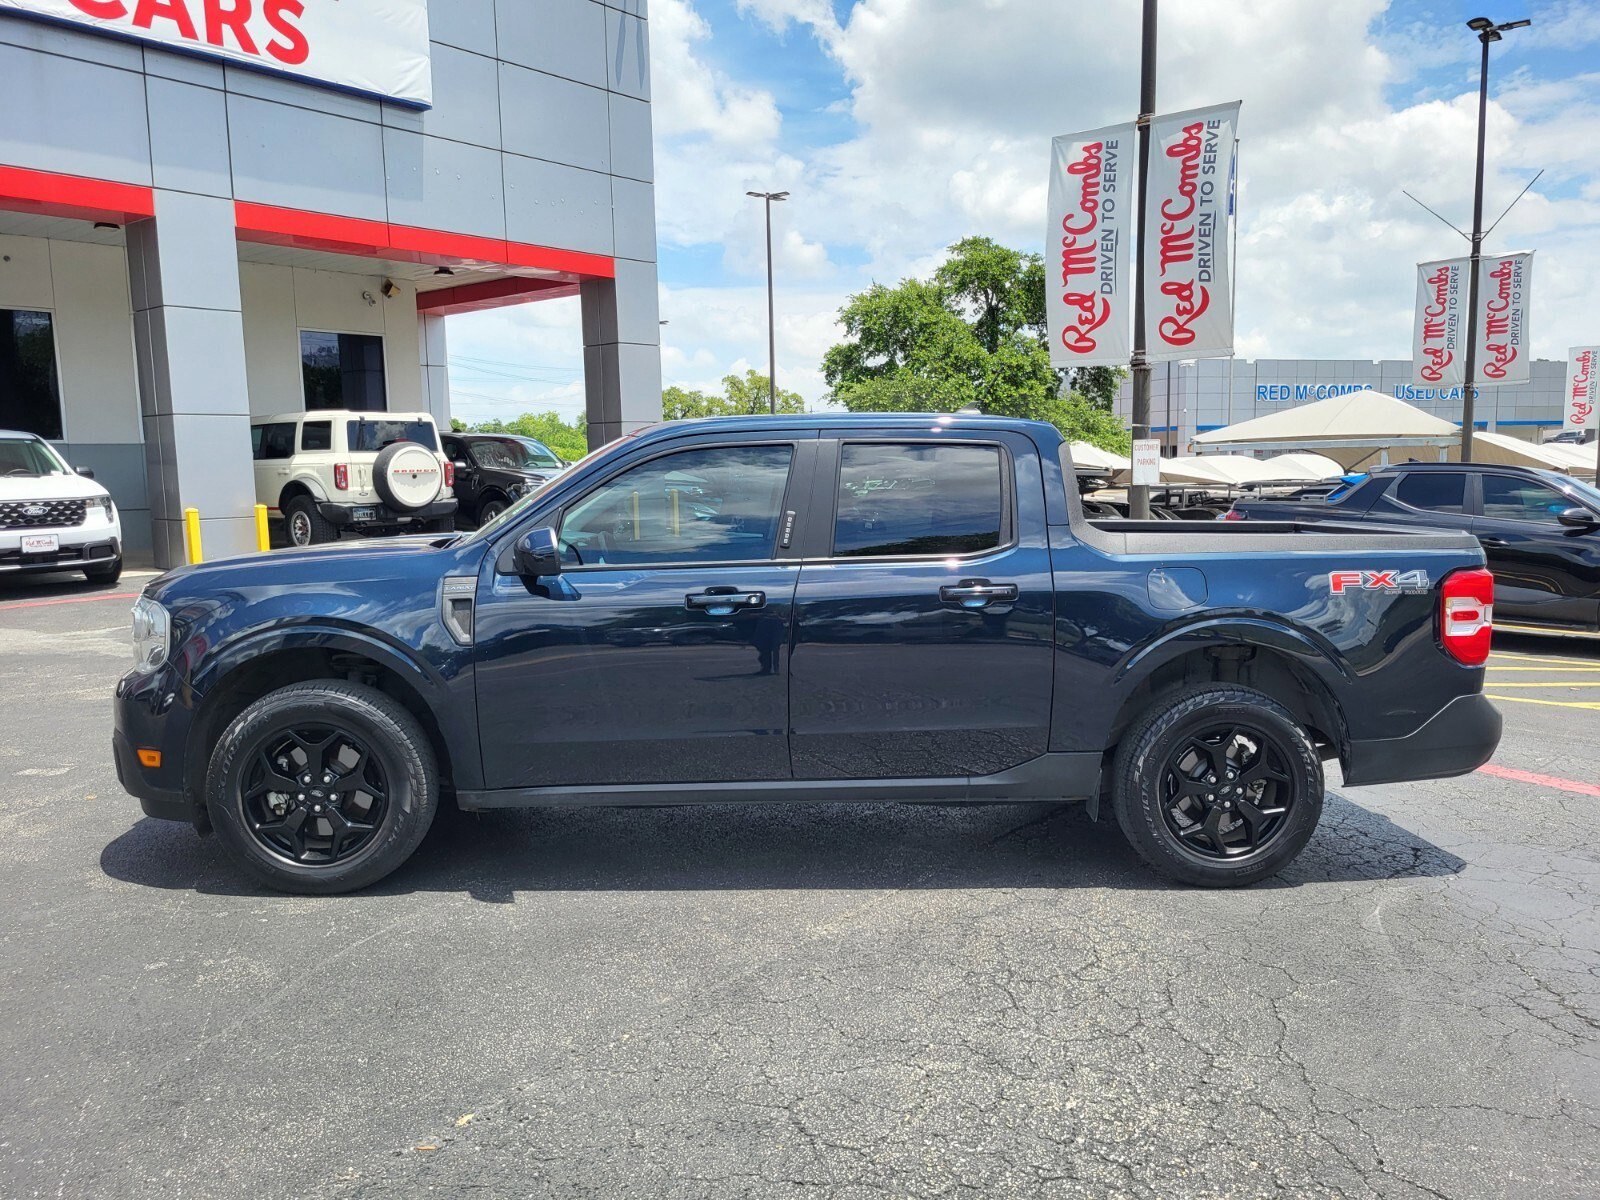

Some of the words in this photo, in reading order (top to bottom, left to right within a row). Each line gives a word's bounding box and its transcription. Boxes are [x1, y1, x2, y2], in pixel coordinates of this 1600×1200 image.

[1202, 119, 1221, 175] SERVE
[1102, 139, 1119, 192] SERVE
[1101, 198, 1116, 223] TO
[1159, 121, 1204, 277] McCombs
[1199, 182, 1215, 206] TO
[1061, 141, 1103, 287] McCombs
[1100, 228, 1114, 295] DRIVEN
[1197, 213, 1213, 283] DRIVEN
[1449, 265, 1459, 294] SERVE
[1513, 260, 1523, 289] SERVE
[1158, 278, 1210, 346] Red
[1422, 266, 1450, 345] McCombs
[1448, 298, 1458, 310] TO
[1485, 260, 1513, 341] McCombs
[1512, 291, 1521, 305] TO
[1062, 290, 1111, 353] Red
[1447, 314, 1456, 350] DRIVEN
[1510, 308, 1520, 346] DRIVEN
[1420, 347, 1453, 381] Red
[1483, 343, 1518, 379] Red
[1572, 350, 1591, 401] McCombs
[1590, 370, 1596, 379] TO
[1256, 384, 1291, 401] RED
[1570, 402, 1593, 424] Red
[1134, 443, 1159, 451] CUSTOMER
[1137, 457, 1156, 466] PARKING
[1329, 569, 1430, 596] FX4
